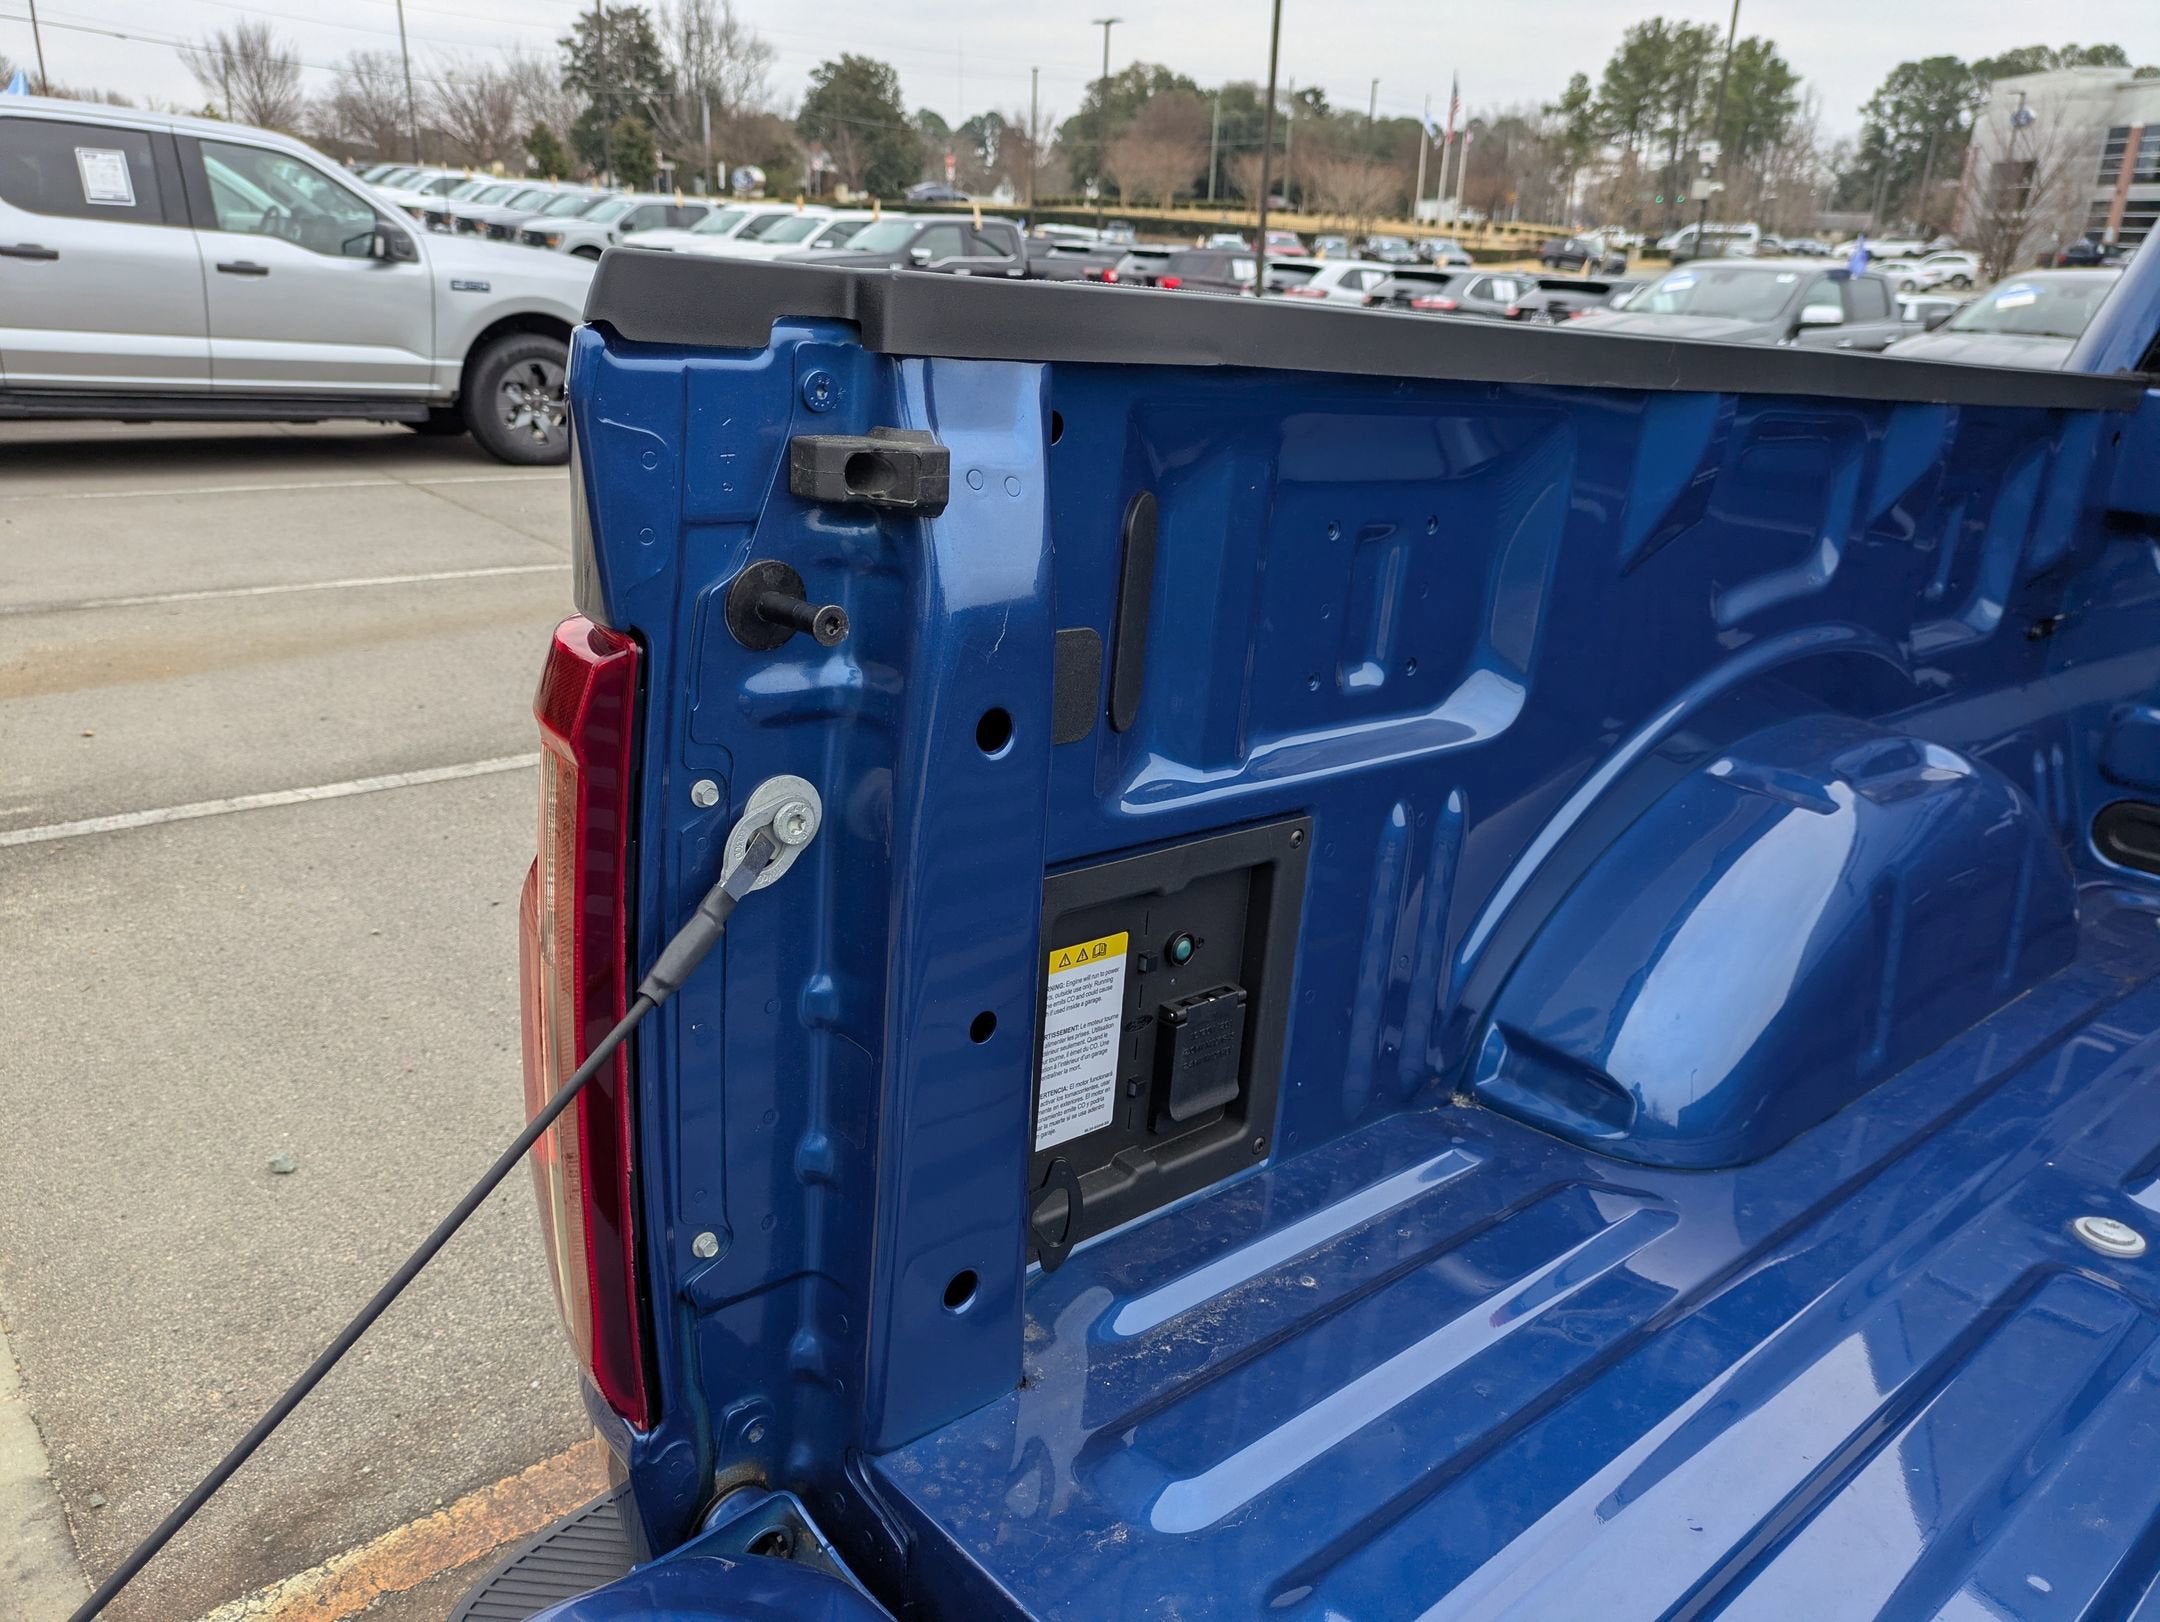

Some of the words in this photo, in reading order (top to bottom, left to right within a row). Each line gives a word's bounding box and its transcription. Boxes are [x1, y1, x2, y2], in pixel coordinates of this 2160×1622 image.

[1066, 978, 1082, 987] Engine
[1094, 977, 1113, 986] Running
[1086, 989, 1098, 997] could
[1092, 1049, 1107, 1058] garage
[1091, 1089, 1103, 1097] motor
